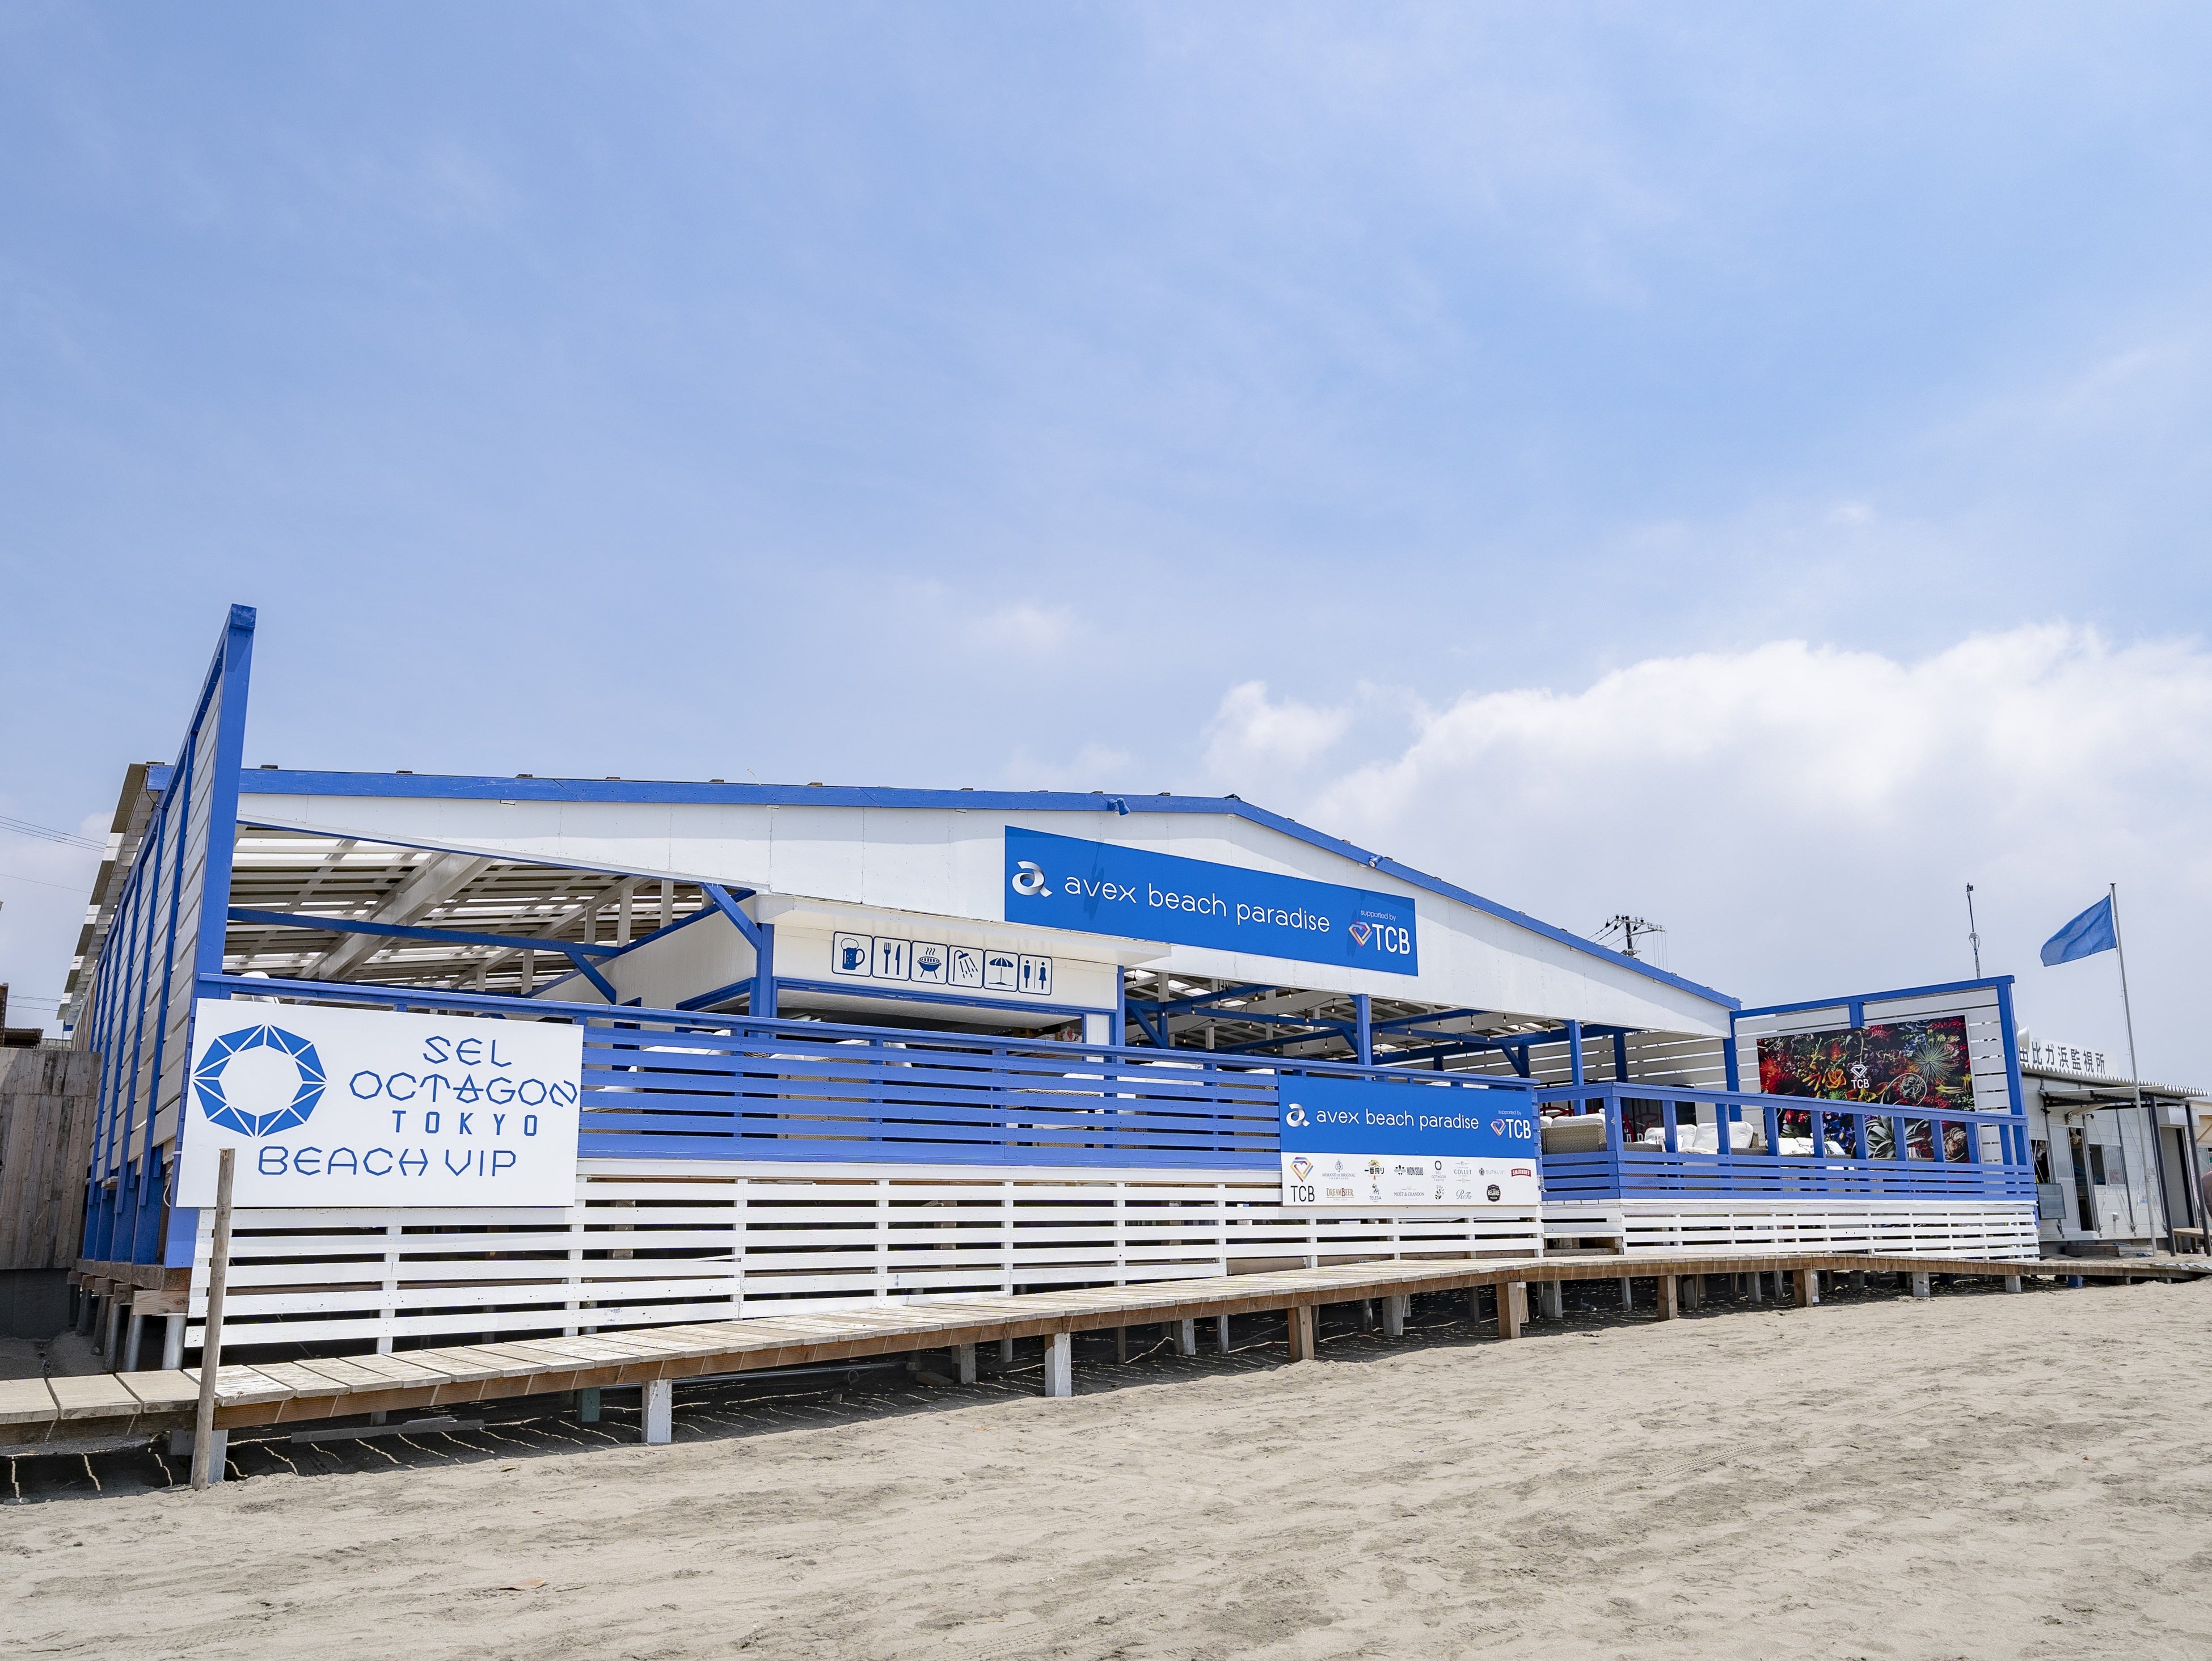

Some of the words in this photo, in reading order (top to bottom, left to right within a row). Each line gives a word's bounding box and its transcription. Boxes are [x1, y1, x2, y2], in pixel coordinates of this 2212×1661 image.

[1064, 876, 1137, 904] avex
[1148, 882, 1227, 917] beach
[1236, 903, 1331, 933] paradise
[1361, 910, 1388, 920] supported
[1371, 923, 1411, 955] TCB
[423, 1035, 513, 1068] SEL
[349, 1069, 578, 1108] OCTAGON
[1851, 1078, 1870, 1089] TCB
[391, 1110, 538, 1137] TOKYO
[1316, 1110, 1360, 1124] avex
[1366, 1108, 1415, 1127] beach
[1419, 1113, 1479, 1131] paradise
[1505, 1118, 1531, 1139] TCB
[257, 1145, 429, 1177] BEACH
[445, 1149, 517, 1178] VIP
[1407, 1167, 1415, 1175] WON
[1290, 1185, 1315, 1202] TCB
